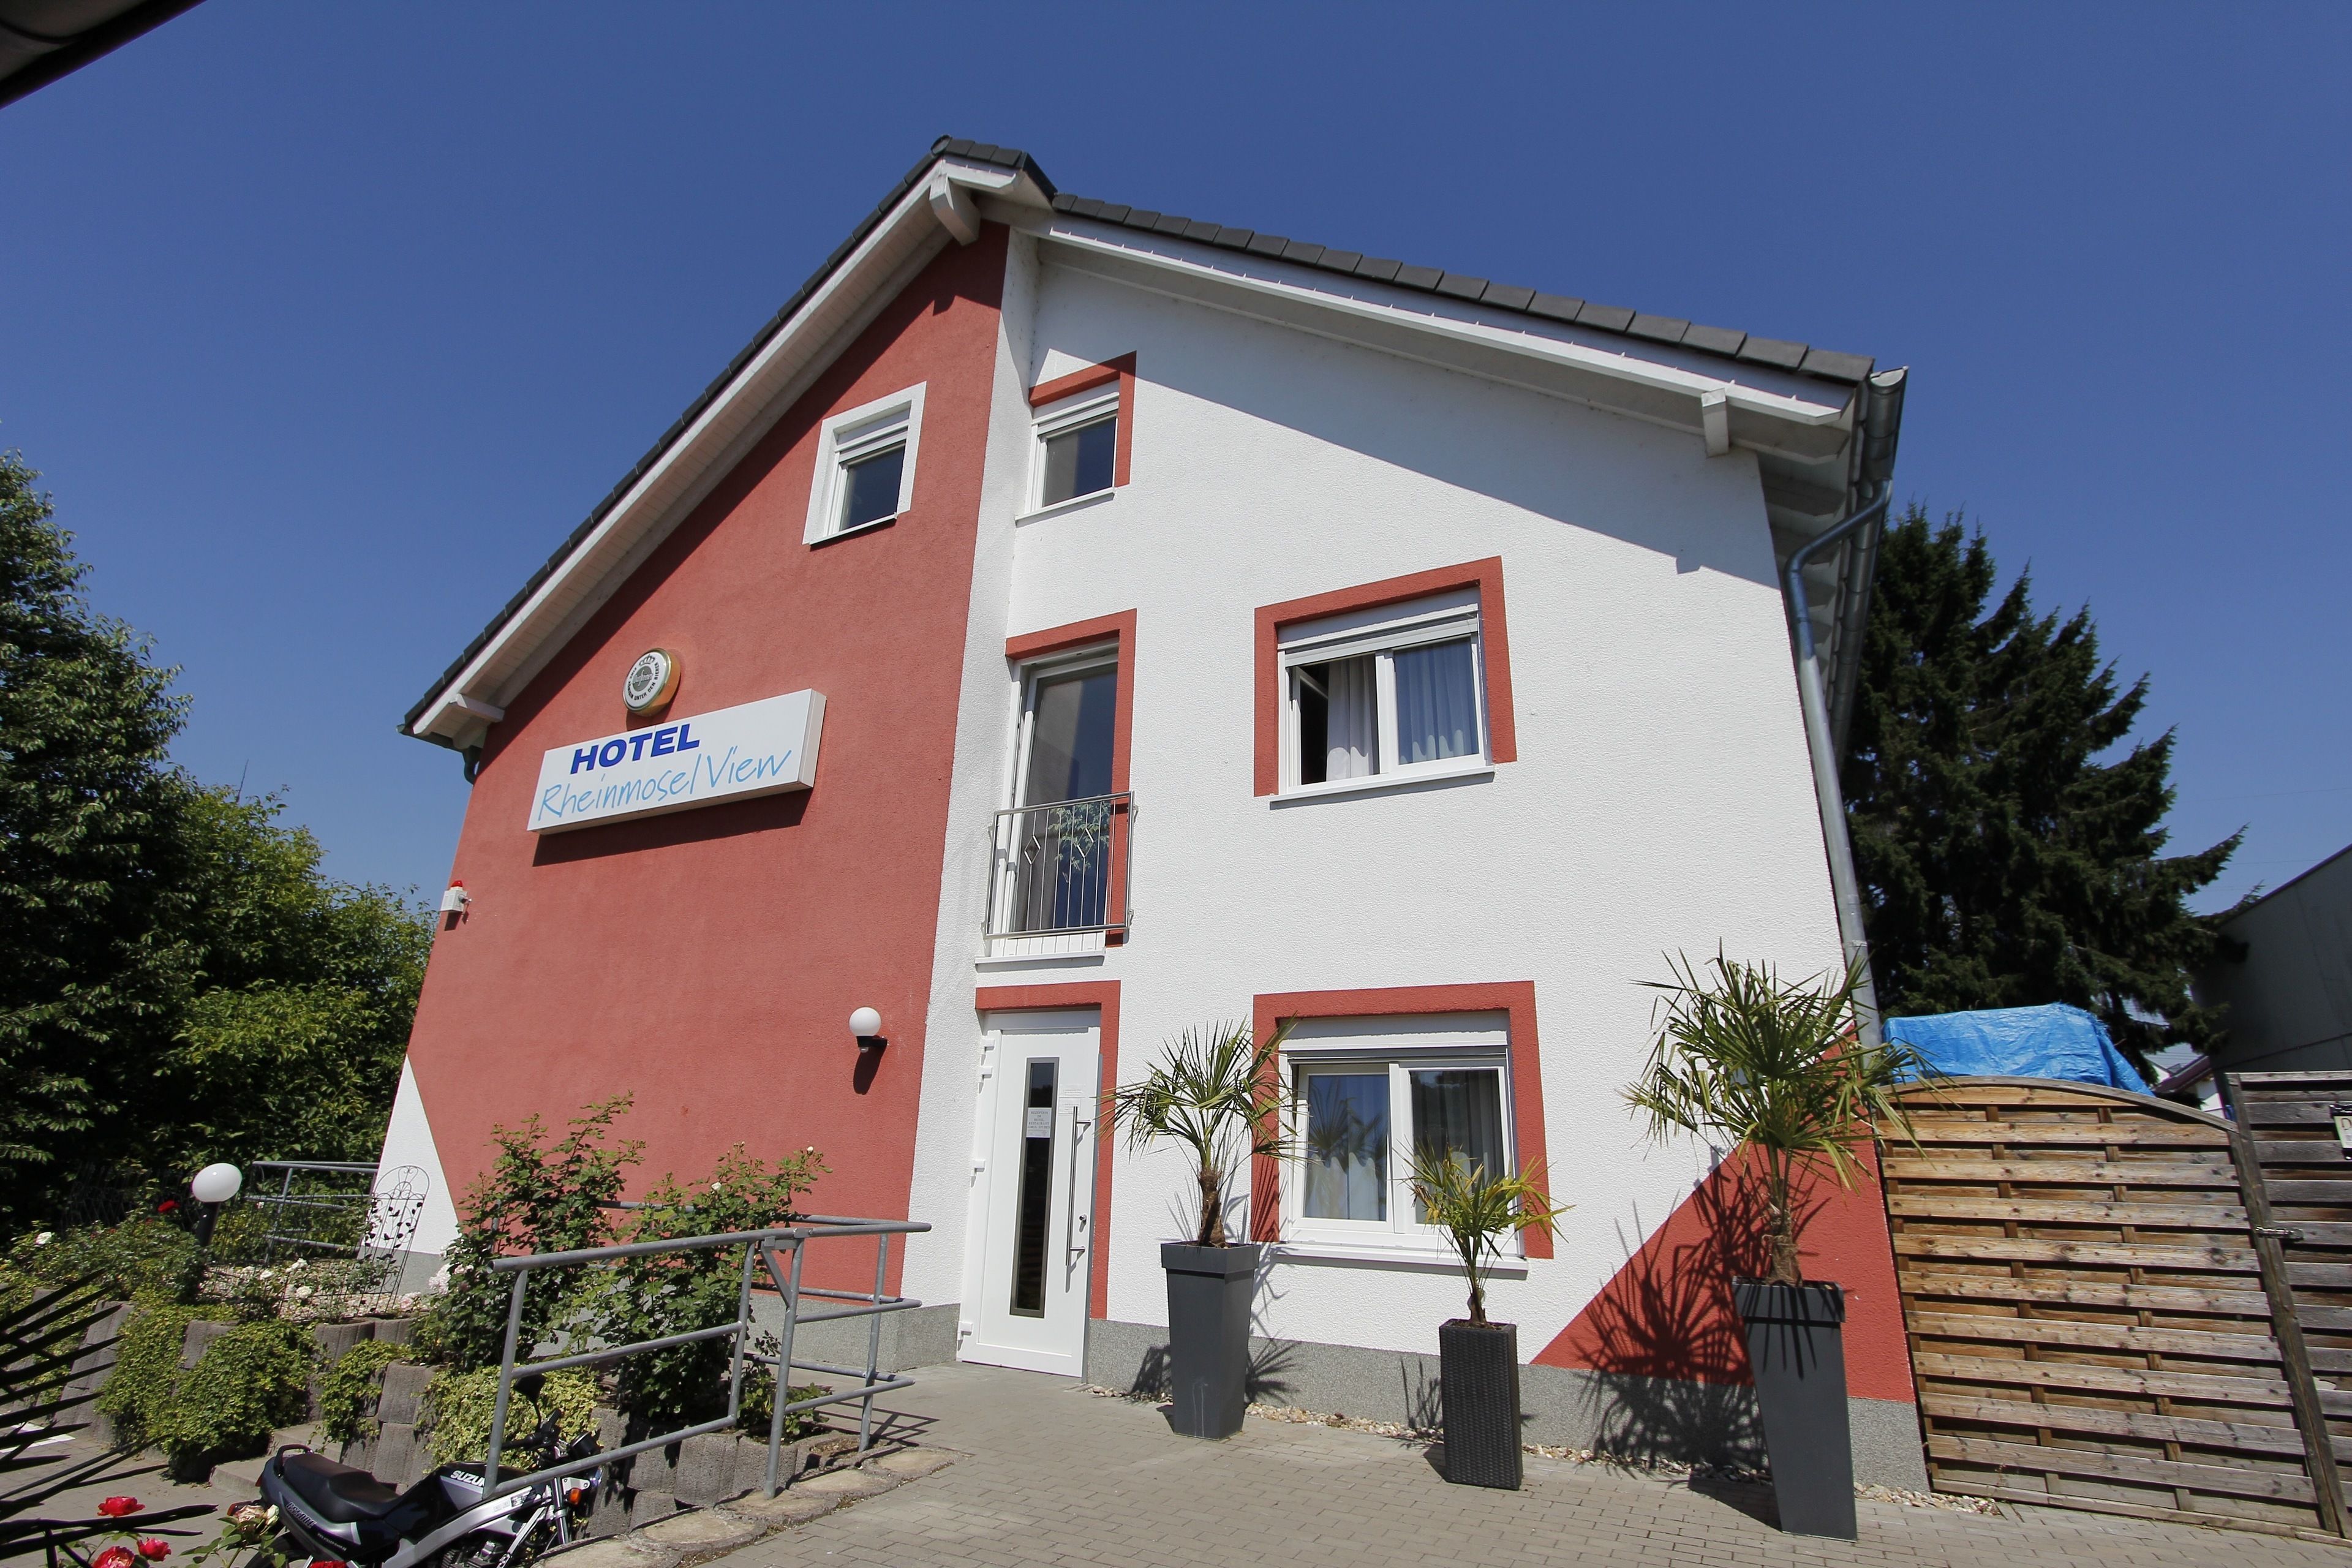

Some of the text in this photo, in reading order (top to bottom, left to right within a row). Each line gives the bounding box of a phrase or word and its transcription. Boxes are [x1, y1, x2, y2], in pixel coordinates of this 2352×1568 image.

[570, 723, 700, 775] HOTEL
[538, 745, 792, 821] Rheinmosel View
